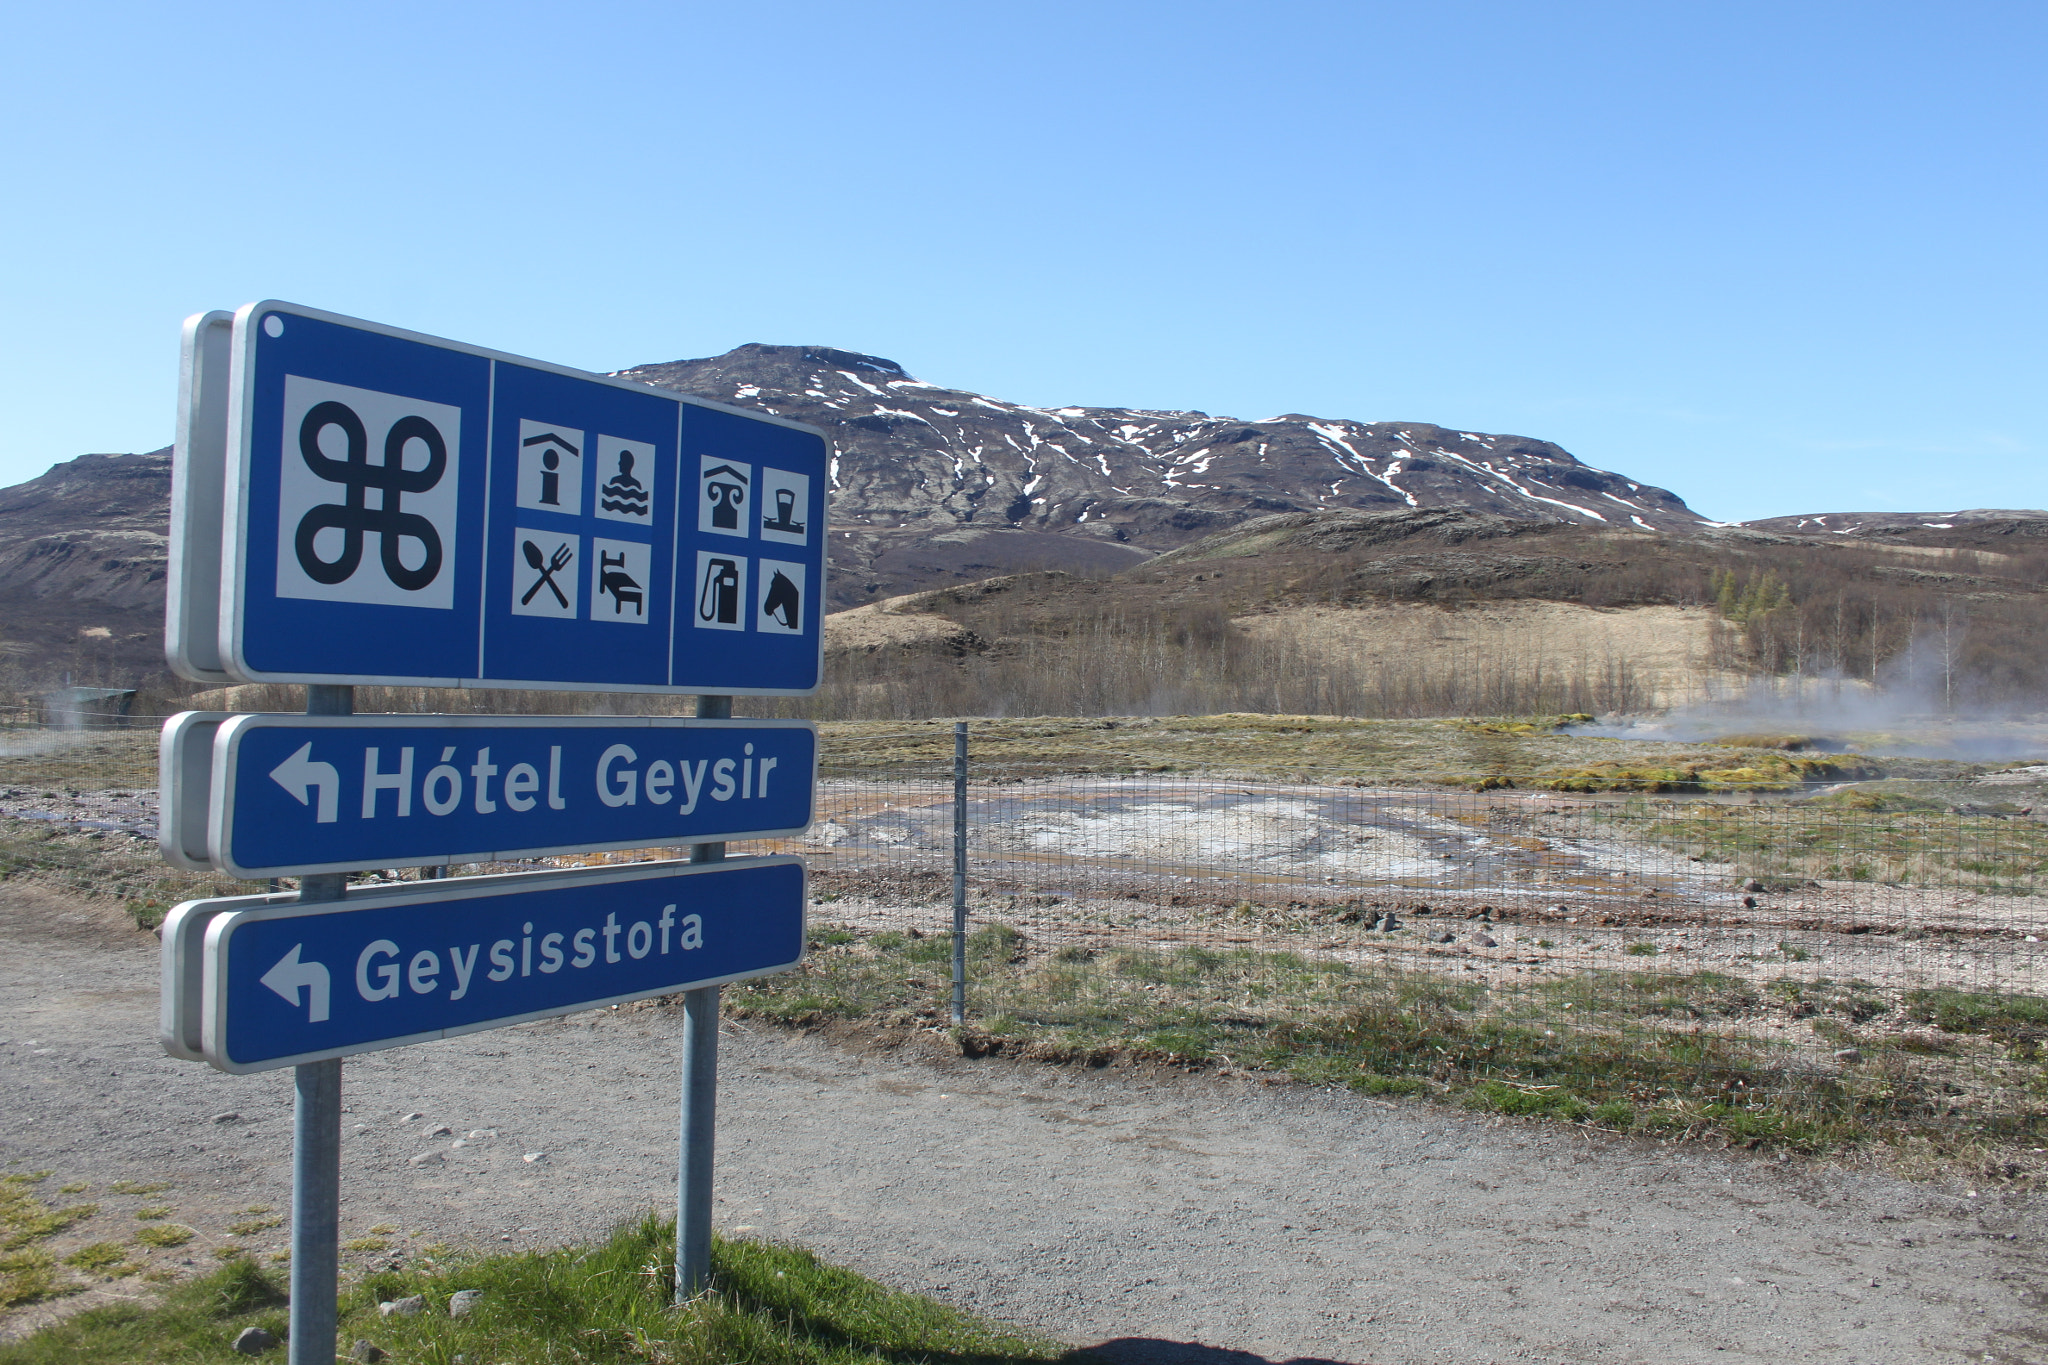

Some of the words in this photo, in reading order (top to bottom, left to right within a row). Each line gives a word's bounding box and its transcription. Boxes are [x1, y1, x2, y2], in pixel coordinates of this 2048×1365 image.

[362, 745, 566, 819] Hótel
[596, 743, 777, 815] Geysir
[356, 904, 703, 1001] Geysisstofa
